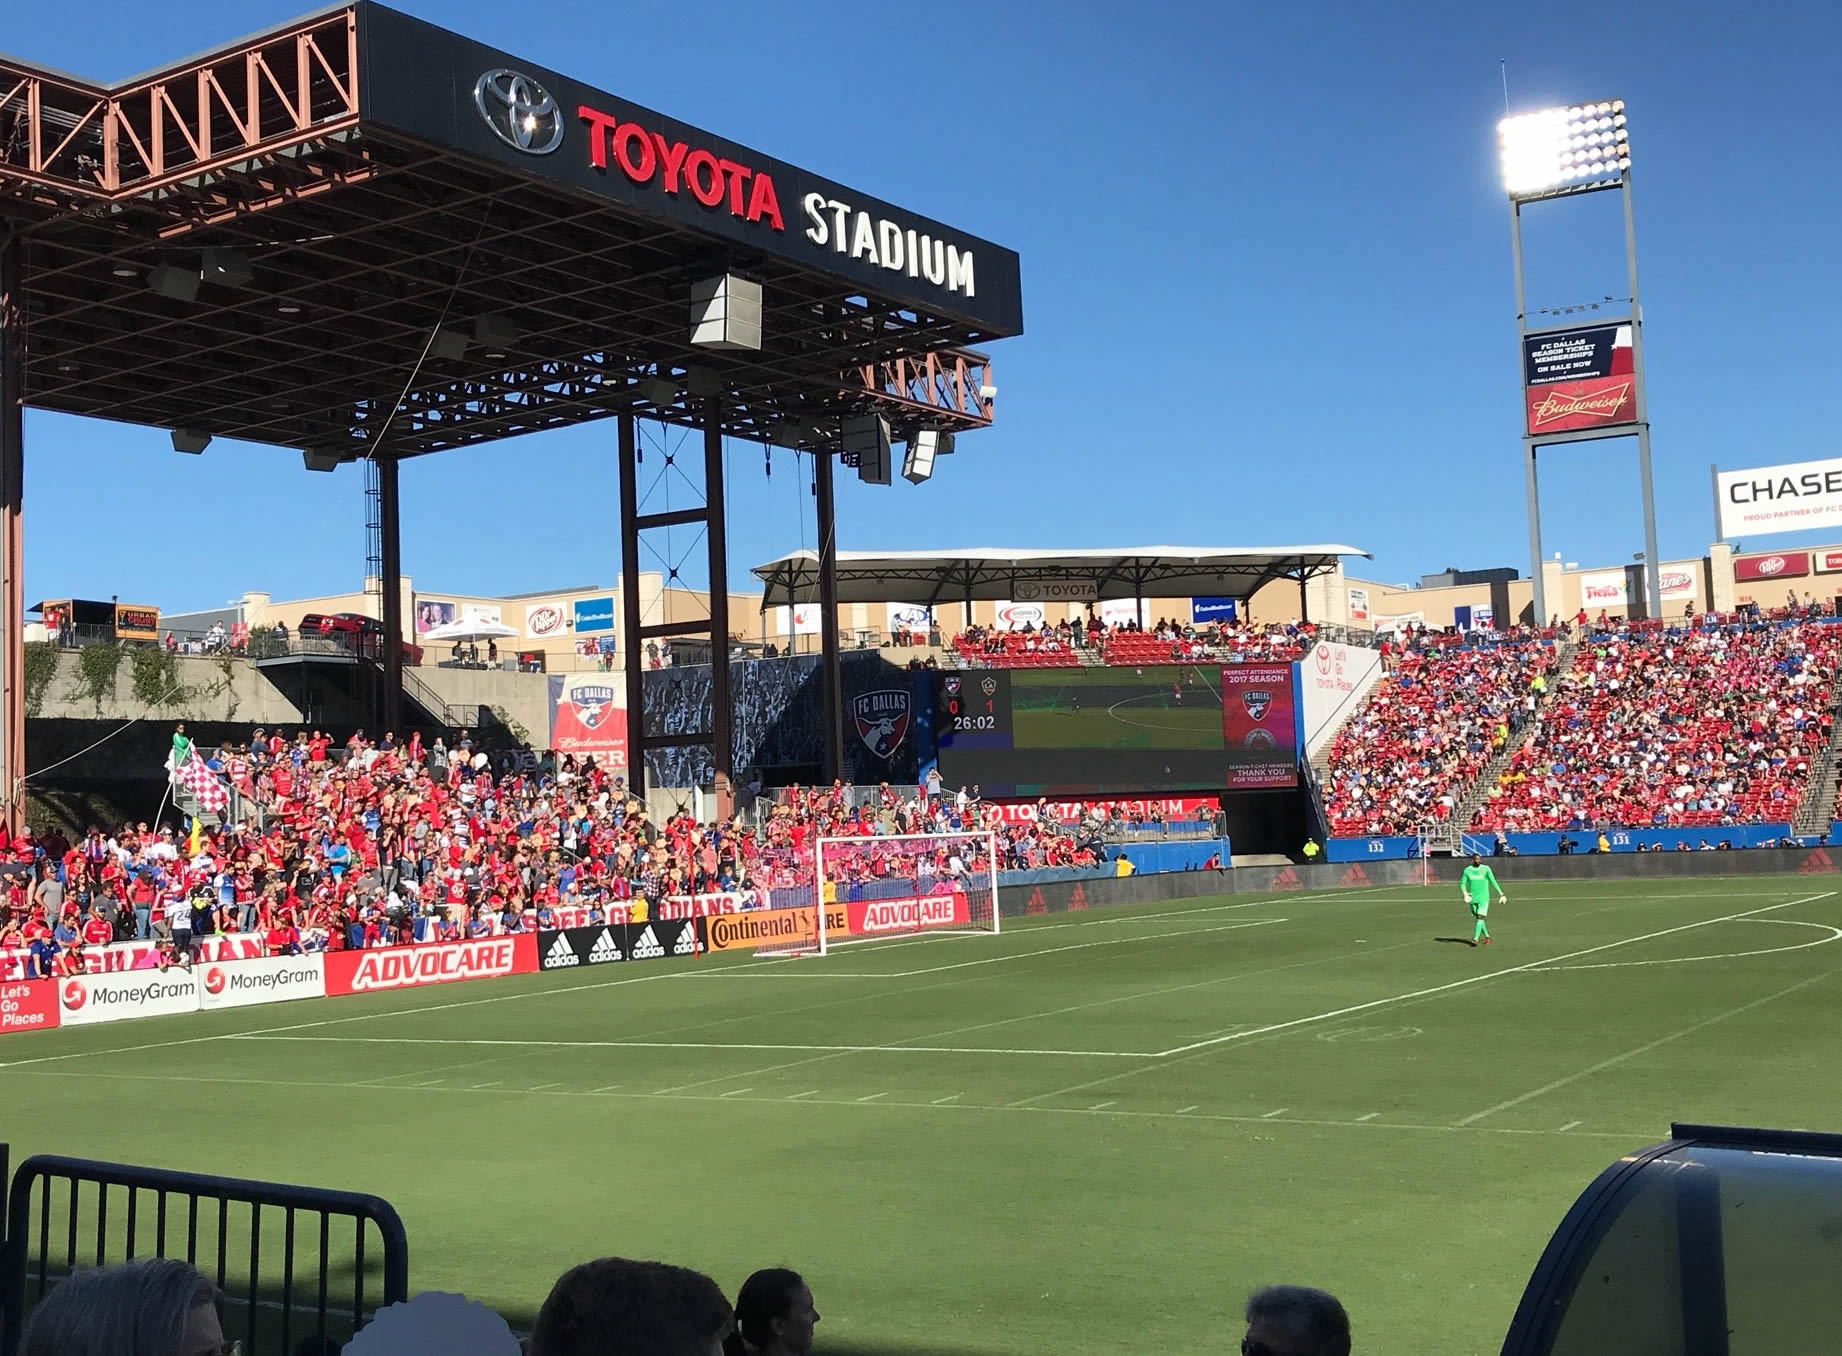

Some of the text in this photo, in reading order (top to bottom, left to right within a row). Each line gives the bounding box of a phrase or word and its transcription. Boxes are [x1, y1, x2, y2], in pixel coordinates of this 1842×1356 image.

[577, 105, 975, 298] TOYOTA STADIUM
[1553, 338, 1586, 348] DALLAS
[1531, 344, 1596, 358] SEASON TICKET
[1534, 350, 1594, 364] MEMBERSHIPS
[1550, 363, 1572, 371] SALE
[1572, 360, 1592, 369] NOW
[1533, 396, 1628, 417] Budweiser
[1730, 470, 1842, 504] CHASE
[1743, 513, 1772, 522] PROUD
[1773, 508, 1811, 519] PARTNER
[1812, 506, 1824, 514] OF
[1825, 505, 1837, 513] FC
[1043, 584, 1097, 596] TOYOTA
[1585, 585, 1619, 600] Fiesta
[1229, 674, 1284, 683] 2017 SEASON
[573, 687, 611, 699] FC DALLAS
[858, 694, 906, 714] FC DALLAS
[949, 700, 993, 714] 0 1
[954, 715, 995, 730] 26:02
[558, 737, 625, 748] Budweiser
[1613, 835, 1629, 844] 131
[1368, 843, 1384, 852] 132
[177, 910, 190, 921] 24
[864, 900, 953, 928] ADVOCARE
[711, 912, 797, 948] Continental
[633, 946, 665, 959] adidas
[674, 941, 704, 954] adidas
[544, 955, 579, 968] adidas
[588, 949, 622, 963] adidas
[355, 942, 514, 988] ADVOCARE
[231, 969, 318, 990] MoneyGram
[2, 985, 30, 999] Let's
[93, 982, 194, 1006] MoneyGram
[1, 1000, 18, 1012] Go
[2, 1013, 44, 1026] Places
